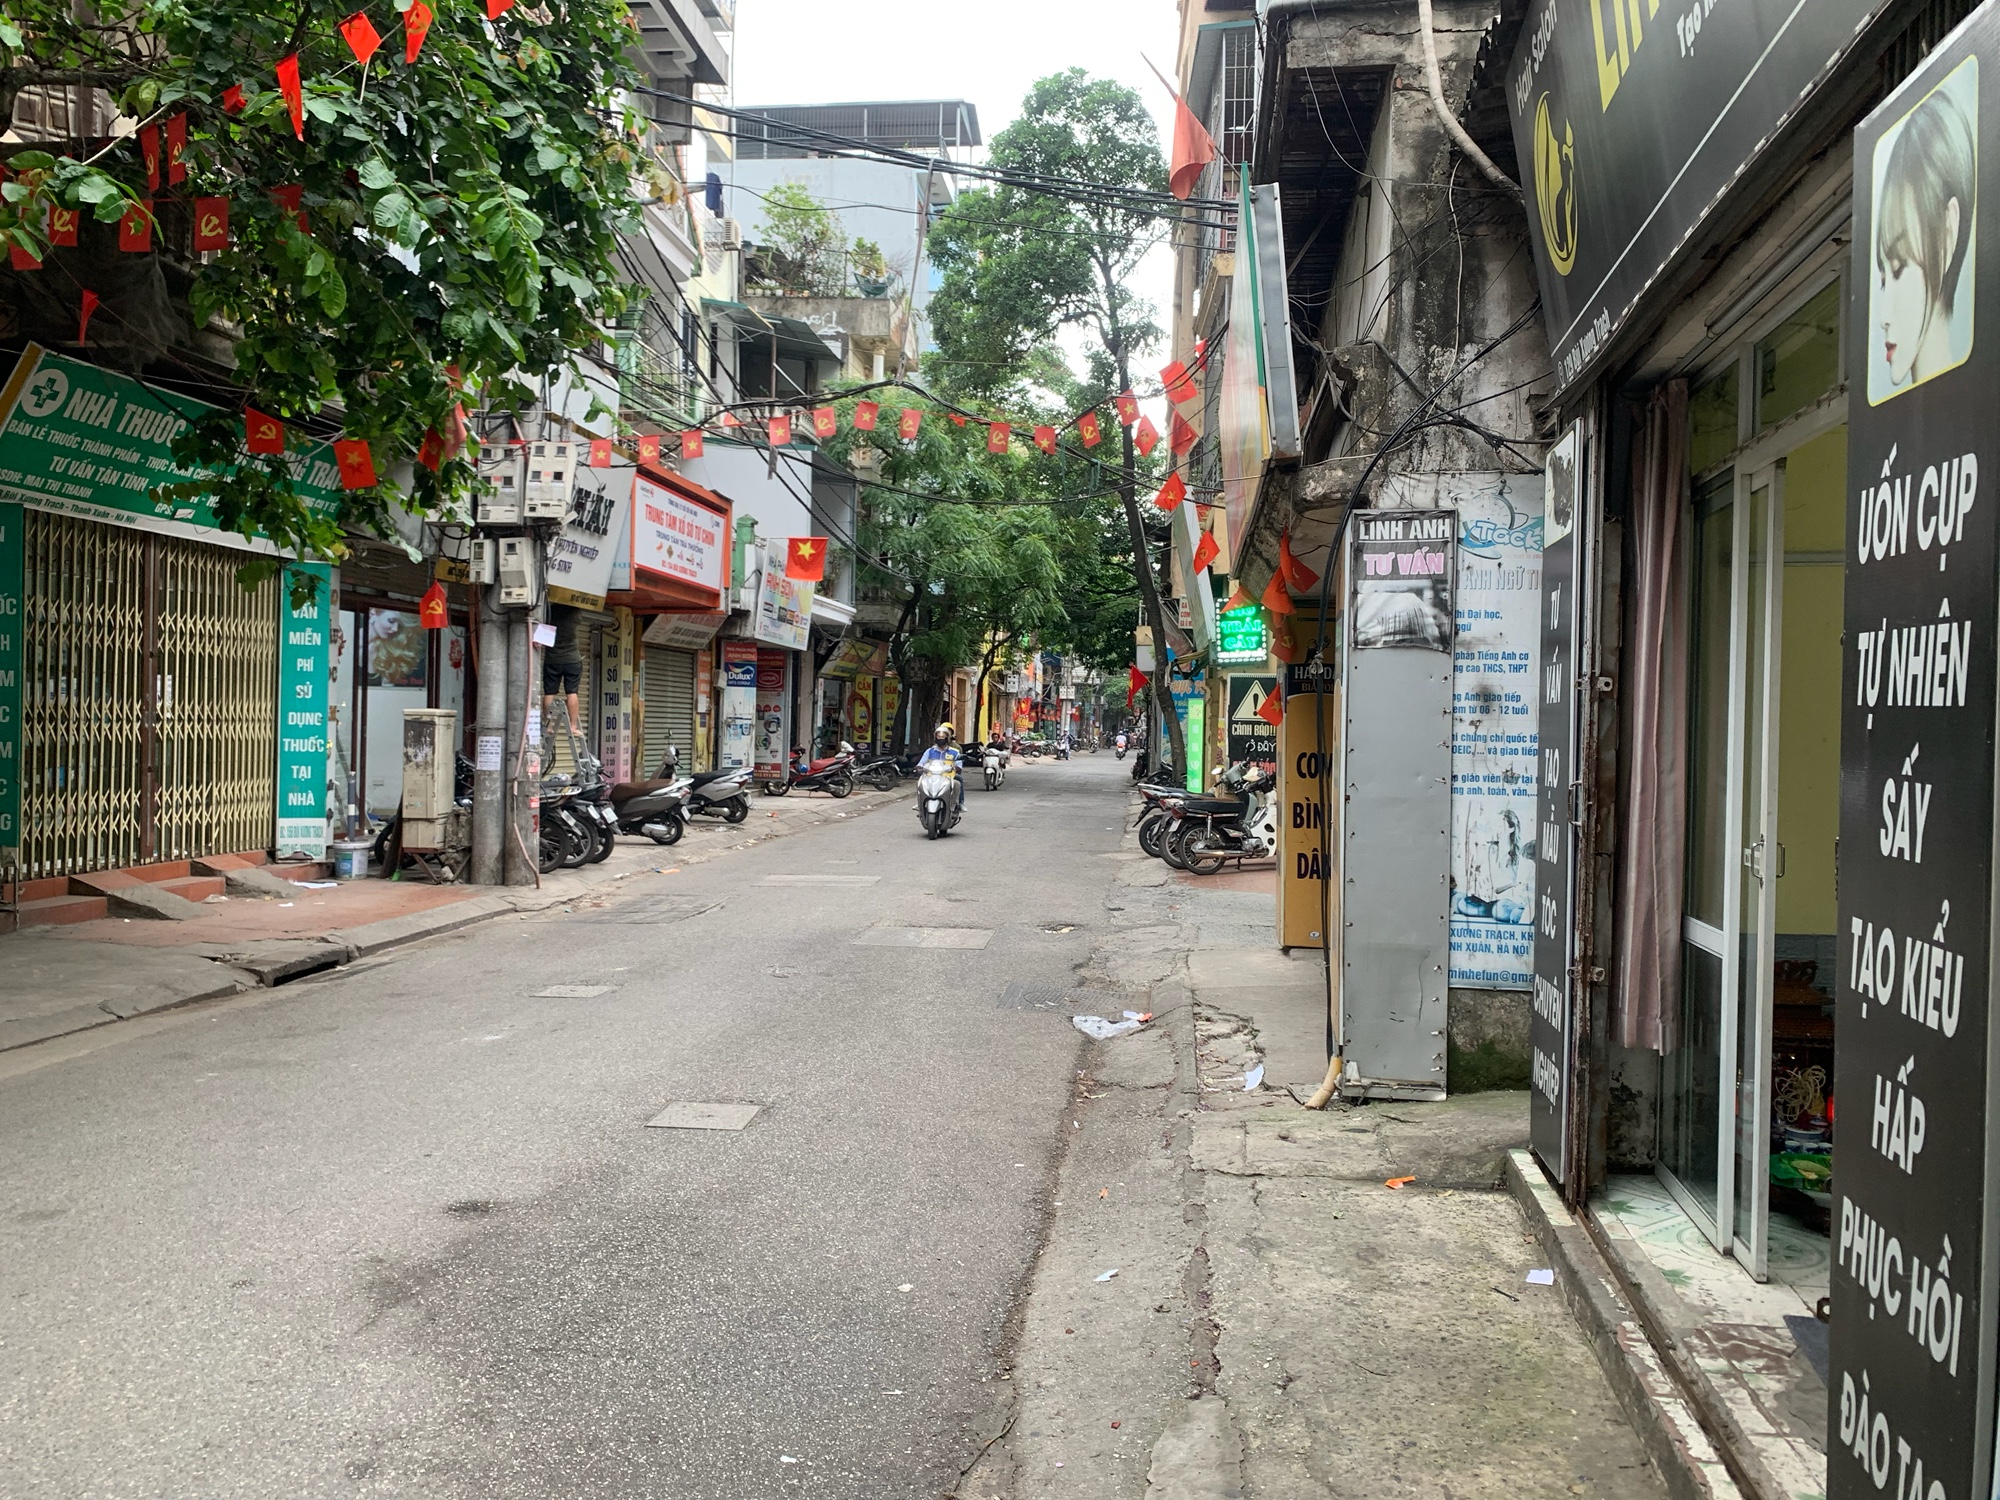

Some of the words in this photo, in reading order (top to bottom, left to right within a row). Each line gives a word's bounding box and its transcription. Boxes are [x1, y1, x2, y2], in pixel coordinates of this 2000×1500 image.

[1515, 56, 1533, 116] Hair
[1531, 1, 1558, 73] Salon
[63, 387, 119, 430] NHÀ
[117, 402, 188, 448] THUỐC
[7, 418, 31, 436] BÁN
[32, 423, 49, 441] LẺ
[47, 429, 82, 449] THUỐC
[81, 438, 114, 458] THÀNH
[112, 446, 143, 465] PHẨM
[145, 455, 170, 473] THỰC
[48, 455, 71, 473] TƯ
[67, 458, 97, 480] VẤN
[94, 465, 123, 487] TẬN
[119, 472, 150, 492] TÌNH
[23, 474, 46, 489] MAI
[44, 479, 63, 495] THỊ
[61, 482, 94, 499] THANH
[70, 503, 92, 518] Thanh
[91, 508, 111, 520] Xuân
[154, 502, 175, 516] GPS:
[1858, 441, 1912, 565] UỐN
[1916, 453, 1978, 572] CỤP
[645, 503, 664, 526] TRUNG
[665, 510, 678, 532] TÂM
[1359, 519, 1404, 541] LINH
[1409, 518, 1450, 540] ANH
[1363, 551, 1396, 576] TƯ
[1397, 545, 1445, 576] VẤN
[1465, 569, 1492, 590] ANH
[1467, 609, 1482, 621] Đại
[1484, 610, 1503, 621] học,
[1550, 582, 1562, 631] TƯ
[1220, 617, 1262, 634] TRÁI
[288, 627, 322, 646] MIỄN
[1224, 634, 1260, 650] CÂY
[296, 656, 315, 672] PHÍ
[1477, 649, 1499, 662] Tiếng
[1501, 651, 1517, 661] Anh
[1519, 652, 1529, 661] cơ
[1856, 617, 1887, 730] TỰ
[1887, 597, 1972, 707] NHIÊN
[607, 664, 618, 682] SỐ
[728, 671, 751, 680] Dulux
[1466, 664, 1480, 672] cao
[1483, 663, 1506, 674] THCS,
[1508, 664, 1528, 673] THPT
[1546, 645, 1563, 704] VẤN
[295, 681, 314, 699] SỬ
[604, 688, 619, 706] THỦ
[1464, 692, 1481, 701] Anh
[1483, 693, 1502, 702] giao
[1504, 691, 1522, 703] tiếp
[1469, 705, 1477, 714] từ
[1479, 705, 1490, 714] 06
[1500, 706, 1510, 715] 12
[1512, 703, 1529, 715] tuổi
[287, 711, 324, 729] DỤNG
[606, 714, 617, 730] ĐÔ
[1231, 721, 1252, 736] CẢNH
[282, 735, 325, 753] THUỐC
[1257, 740, 1277, 753] ĐÂY
[1460, 732, 1487, 743] chứng
[1489, 733, 1503, 743] chỉ
[1506, 732, 1527, 745] quốc
[1529, 732, 1539, 743] tế
[1487, 746, 1497, 755] và
[1500, 747, 1519, 757] giao
[1521, 745, 1539, 757] tiếp
[291, 765, 312, 782] TẠI
[1461, 772, 1480, 784] giáo
[1482, 773, 1500, 783] viên
[1521, 774, 1533, 786] tại
[1545, 748, 1560, 799] TẠO
[287, 790, 316, 806] NHÀ
[1467, 787, 1485, 796] anh,
[1487, 786, 1509, 797] toán,
[1879, 741, 1932, 864] SẤY
[1292, 797, 1332, 830] BÌN
[1541, 885, 1557, 940] TÓC
[1450, 927, 1482, 939] XƯƠNG
[1485, 929, 1518, 943] TRẠCH,
[1465, 941, 1494, 954] XUÂN,
[1497, 942, 1510, 954] HÀ
[1513, 944, 1529, 957] NỘI
[1850, 916, 1896, 1019] TẠO
[1901, 899, 1964, 1038] KIỂU
[1533, 973, 1563, 1033] CHUYÊN
[1533, 1046, 1560, 1115] NGHIỆP
[1872, 1054, 1926, 1175] HẤP
[1839, 1195, 1904, 1320] PHỤC
[1908, 1233, 1963, 1378] HỒI
[1840, 1368, 1891, 1490] ĐÀO
